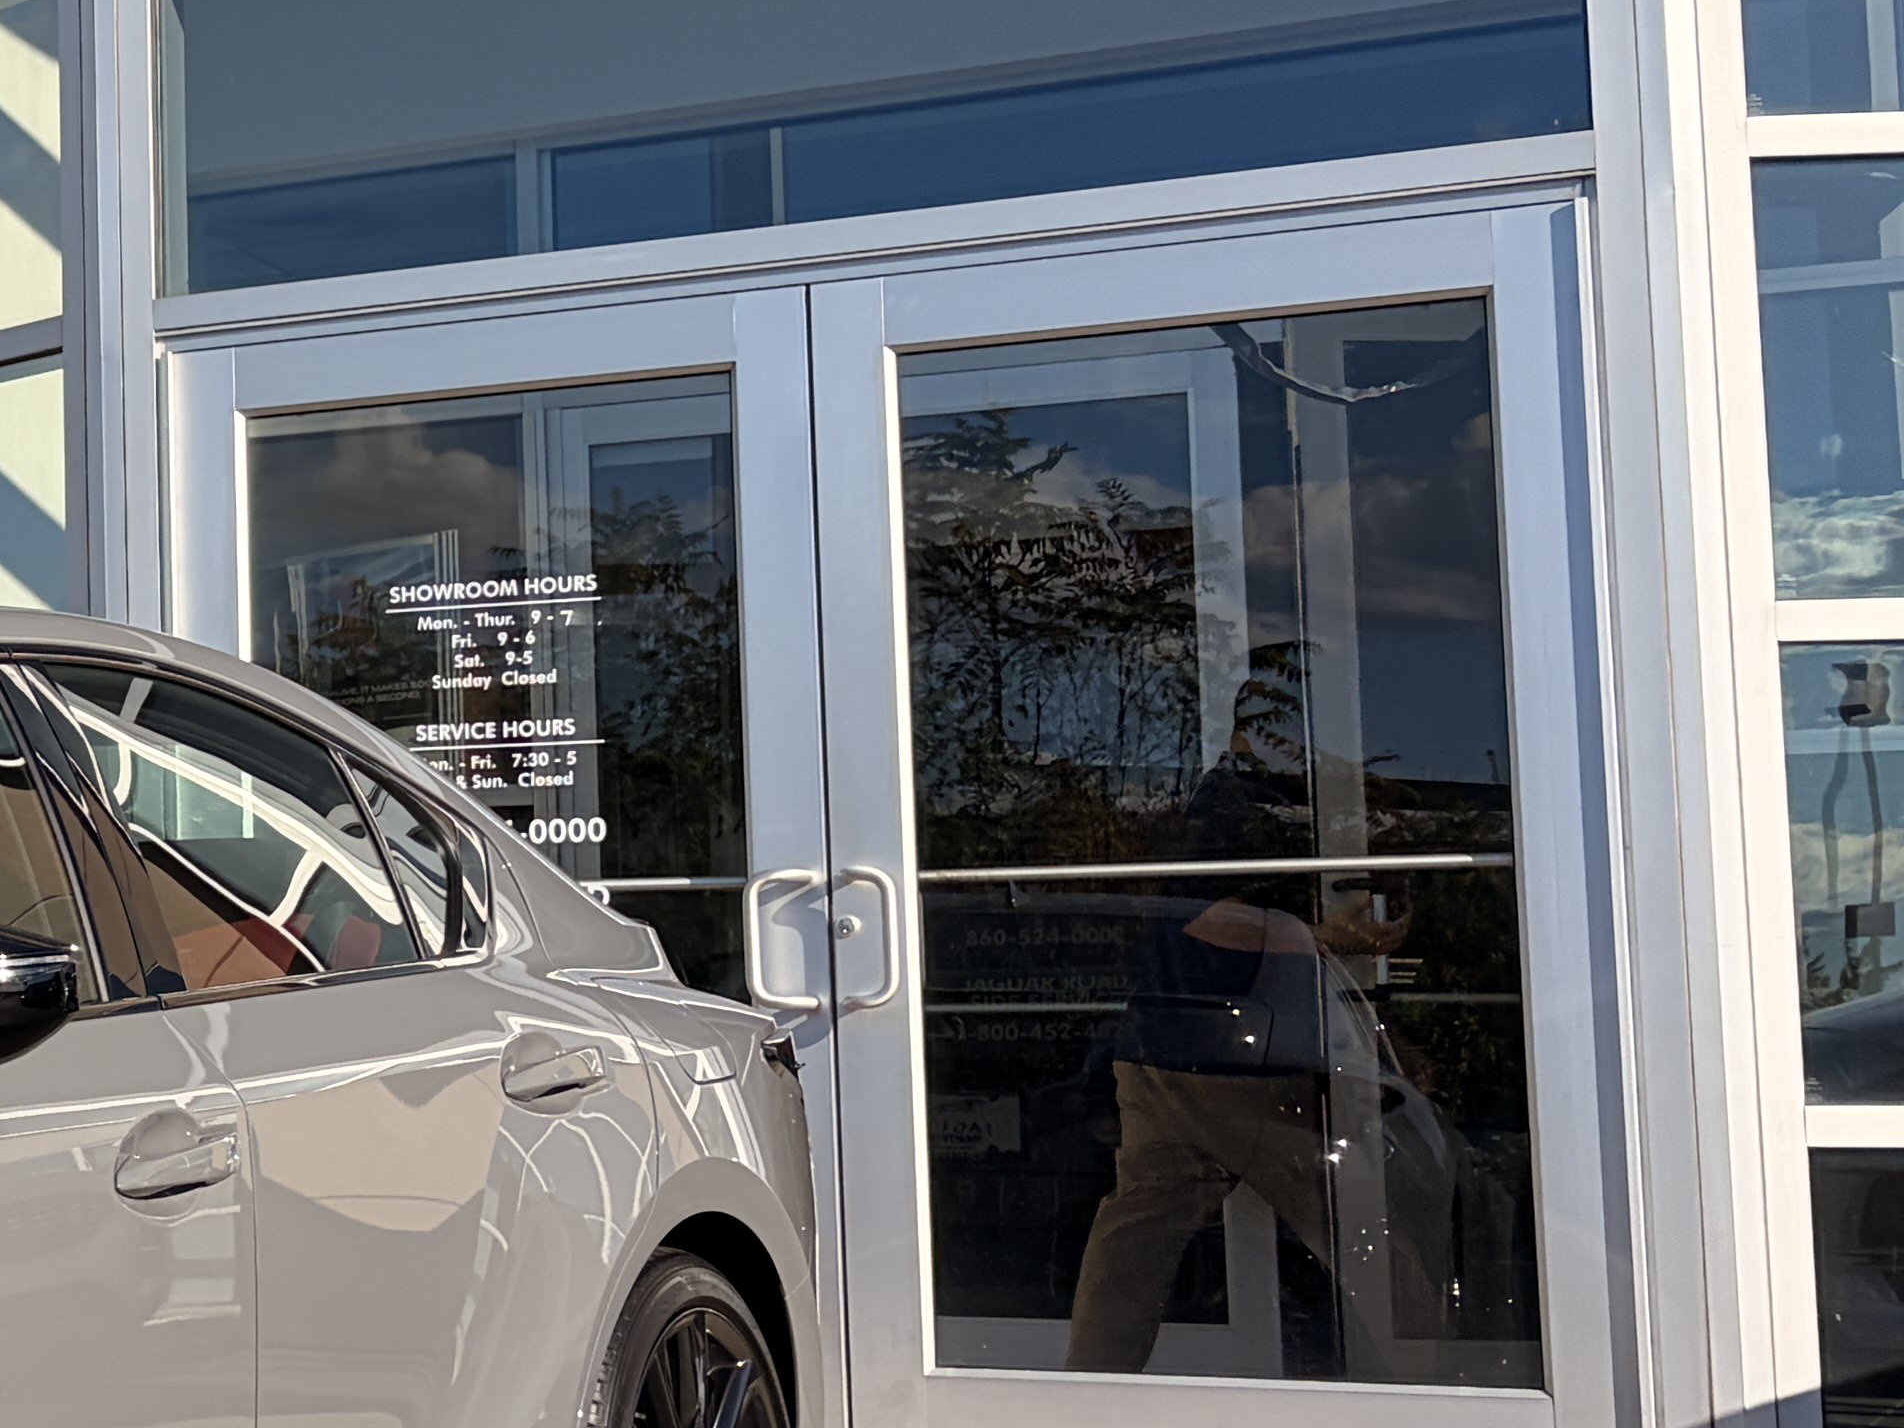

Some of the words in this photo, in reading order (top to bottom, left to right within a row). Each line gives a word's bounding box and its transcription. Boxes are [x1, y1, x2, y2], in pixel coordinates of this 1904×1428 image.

[389, 579, 518, 604] SHOWROOM
[524, 574, 598, 595] HOURS
[417, 616, 458, 631] Mon.
[474, 612, 516, 628] Thur.
[531, 610, 542, 625] 9
[559, 610, 574, 626] 7
[451, 634, 477, 649] Fri.
[497, 632, 508, 646] 9
[525, 630, 536, 645] 6
[454, 654, 485, 669] Sat.
[505, 650, 533, 666] 9-5
[432, 673, 492, 690] Sunday
[501, 668, 557, 686] Closed
[416, 722, 496, 742] SERVICE
[502, 718, 576, 739] HOURS
[423, 758, 454, 771] on.
[471, 754, 497, 770] Fri.
[511, 752, 549, 768] 7:30
[566, 751, 578, 766] 5
[472, 774, 508, 789] Sun.
[518, 770, 574, 787] Closed
